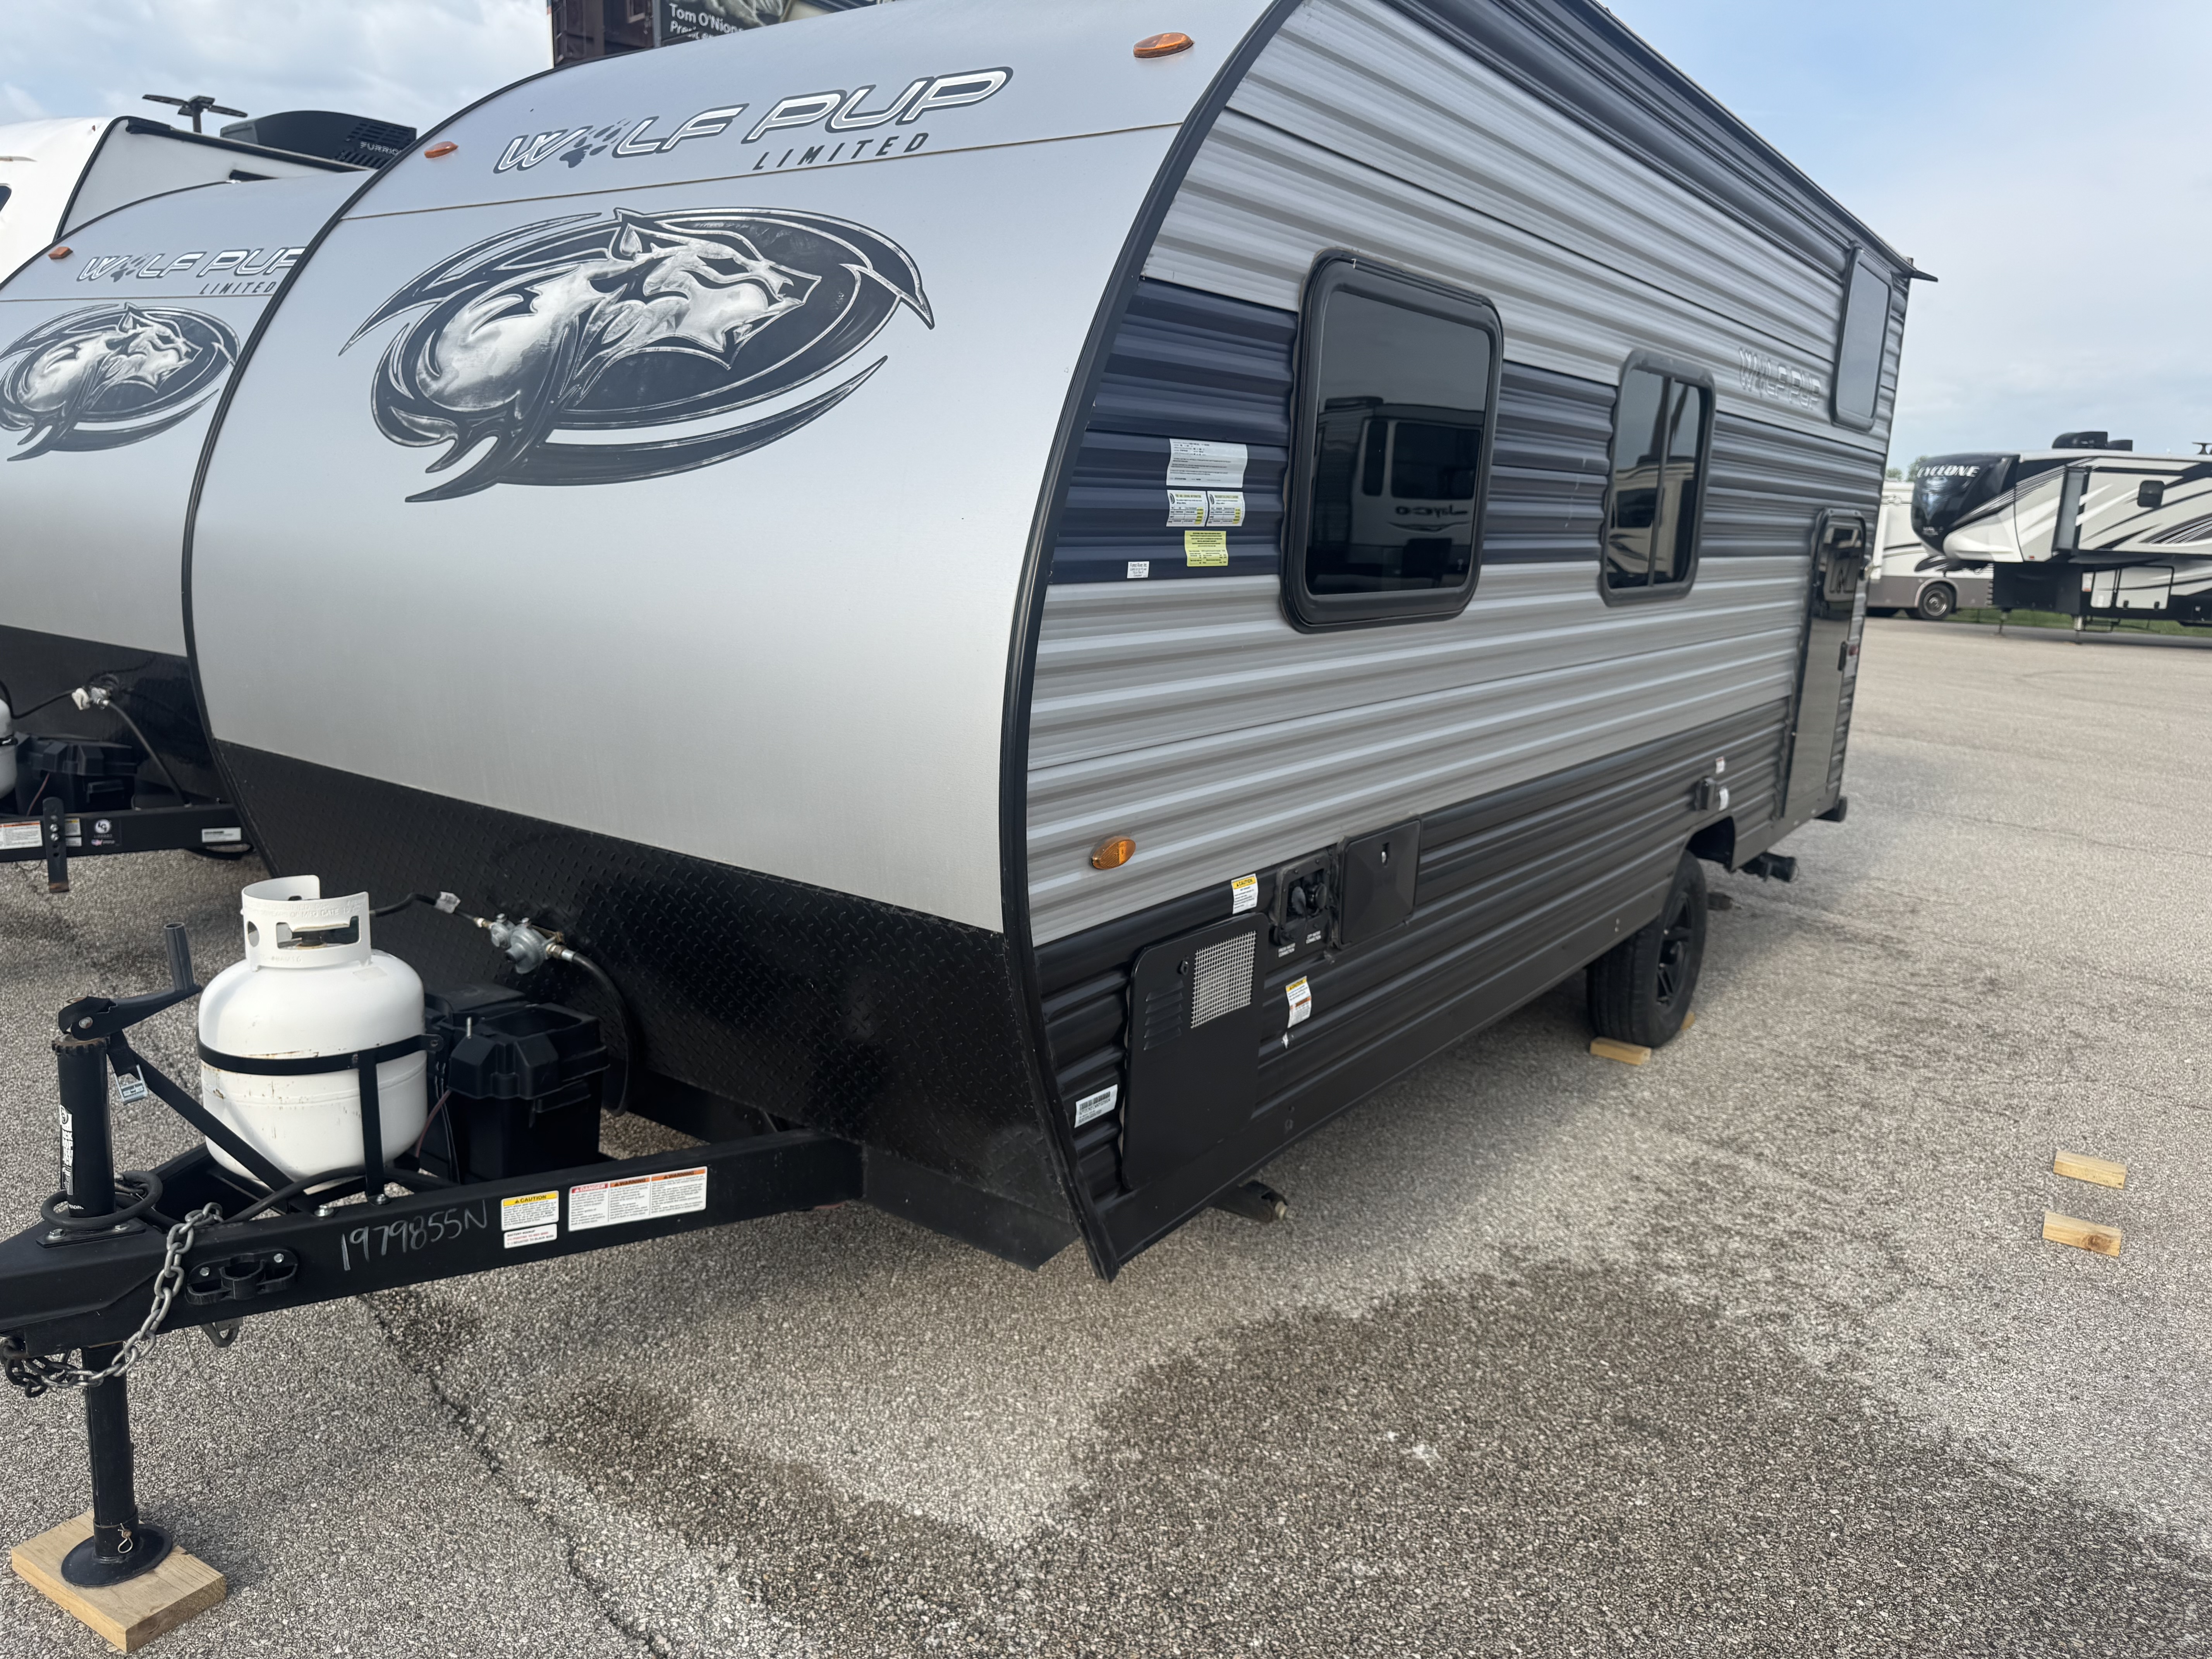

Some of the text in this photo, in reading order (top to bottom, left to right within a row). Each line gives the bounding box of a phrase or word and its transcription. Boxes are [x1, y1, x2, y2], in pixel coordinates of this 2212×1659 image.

[669, 3, 696, 23] Tom
[741, 66, 1014, 144] PUP
[360, 141, 402, 156] FURRIO
[752, 132, 929, 170] LIMITED
[199, 281, 277, 295] LIMITED
[1917, 465, 1980, 478] CYCLONE
[619, 1178, 646, 1187] WARNING
[520, 1194, 547, 1202] CAUTION
[341, 1199, 488, 1271] 1979855N
